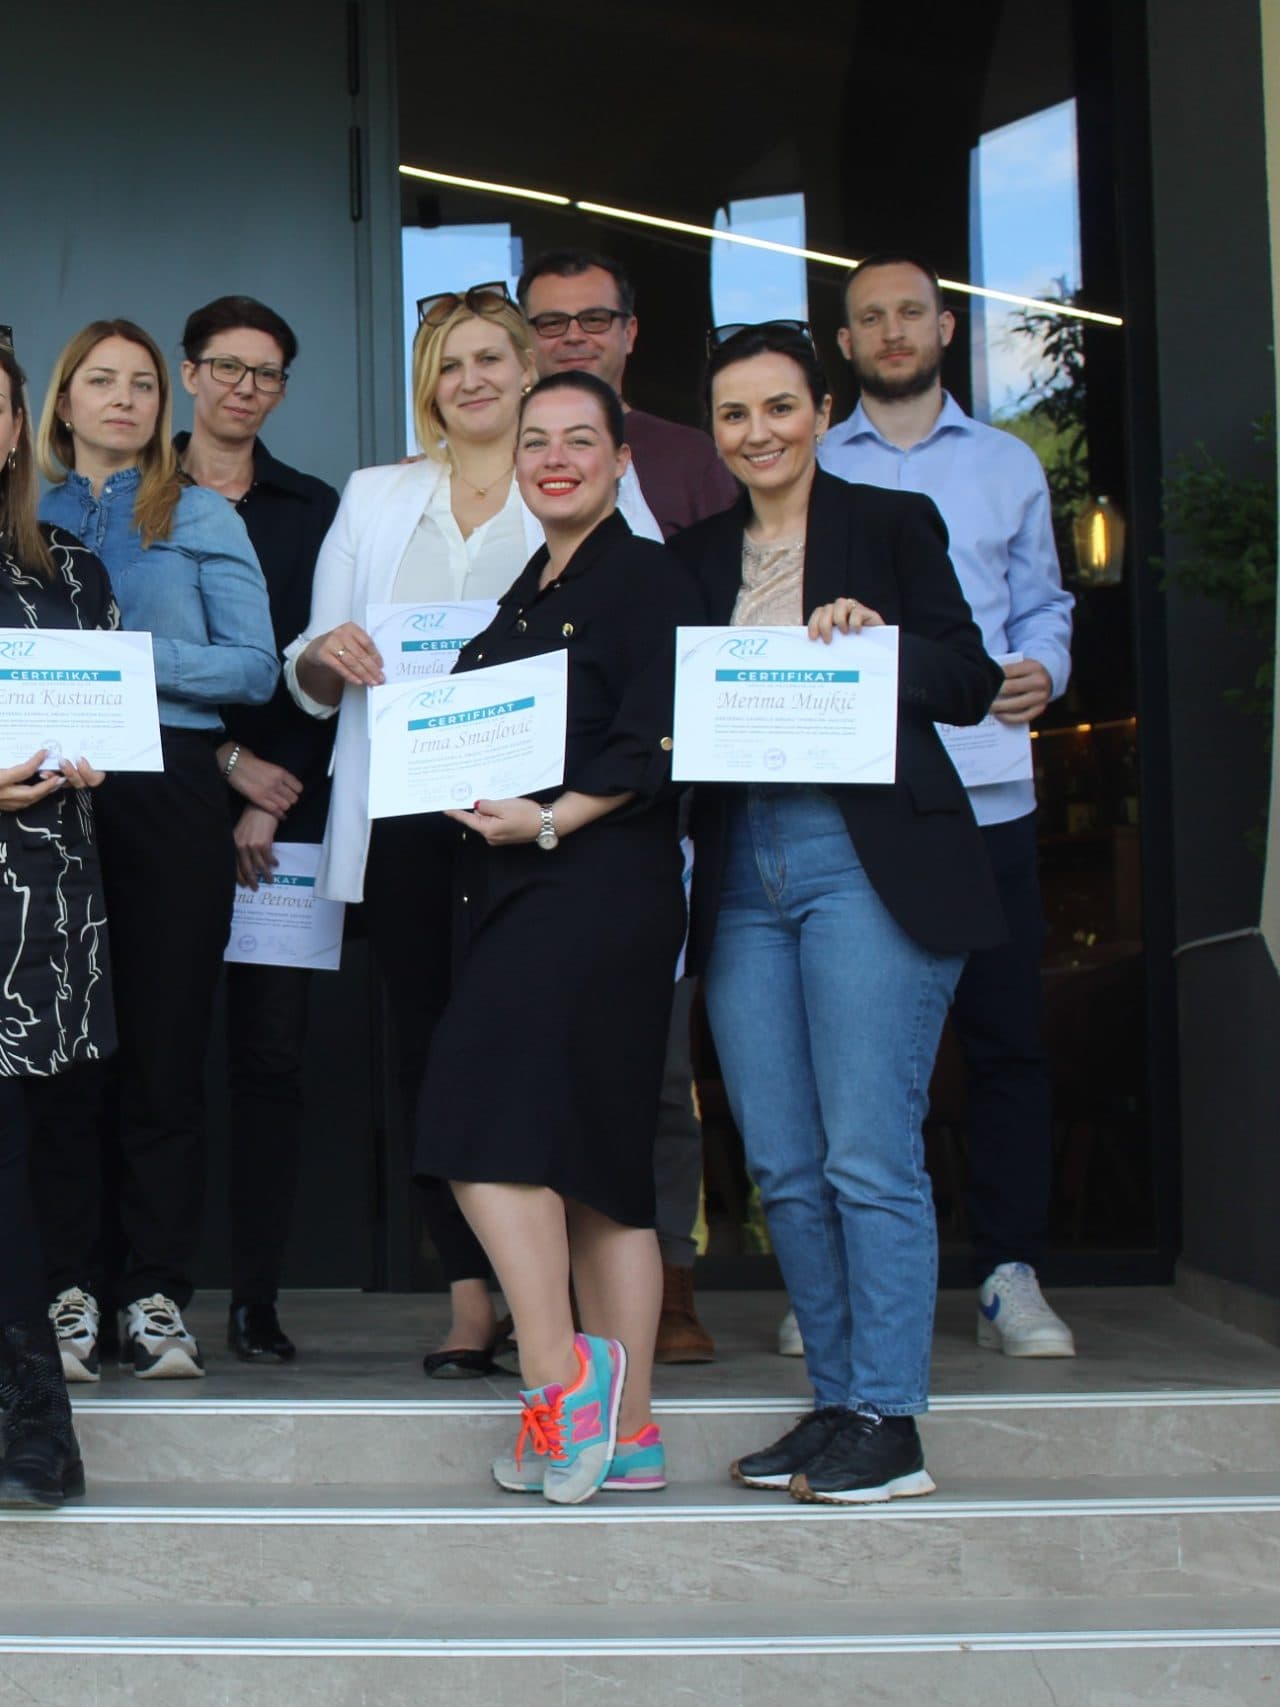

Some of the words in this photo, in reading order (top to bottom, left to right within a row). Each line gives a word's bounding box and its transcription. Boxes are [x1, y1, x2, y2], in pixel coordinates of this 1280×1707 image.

[421, 640, 463, 650] CERTI
[10, 670, 100, 681] CERTIFIKAT
[736, 671, 836, 682] CERTIFIKAT
[40, 688, 124, 708] Kusturica
[717, 691, 785, 710] Merima
[791, 690, 857, 715] Mujkić
[428, 703, 516, 728] CERTIFIKAT
[410, 738, 450, 754] Irma
